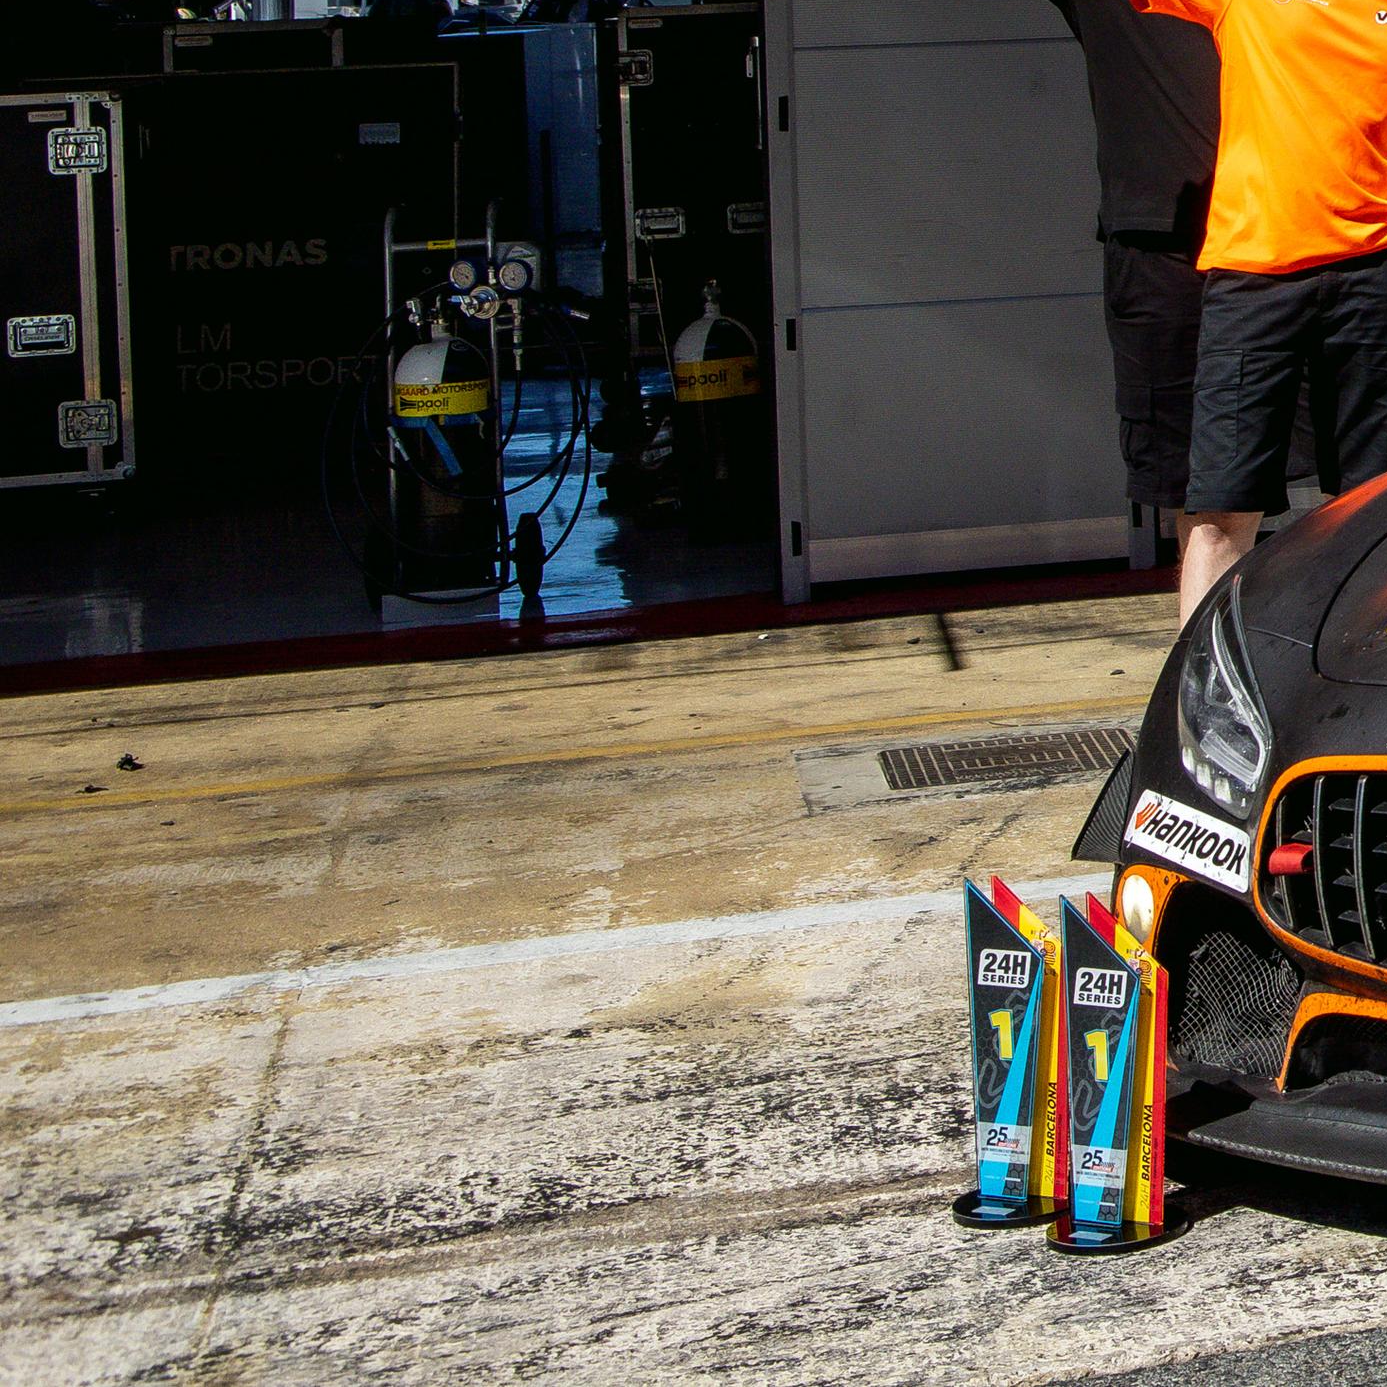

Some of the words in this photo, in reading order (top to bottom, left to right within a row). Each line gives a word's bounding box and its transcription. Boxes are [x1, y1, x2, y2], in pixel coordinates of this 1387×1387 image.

[983, 951, 1028, 975] 24H
[981, 972, 1026, 986] SERIES
[1079, 970, 1124, 995] 24H
[1078, 991, 1122, 1006] SERIES
[989, 1008, 1015, 1061] 1
[1083, 1027, 1111, 1082] 1
[1046, 1081, 1058, 1157] BARCELONA
[986, 1126, 1009, 1146] 25
[1141, 1104, 1153, 1182] BARCELONA
[1081, 1149, 1103, 1170] 25
